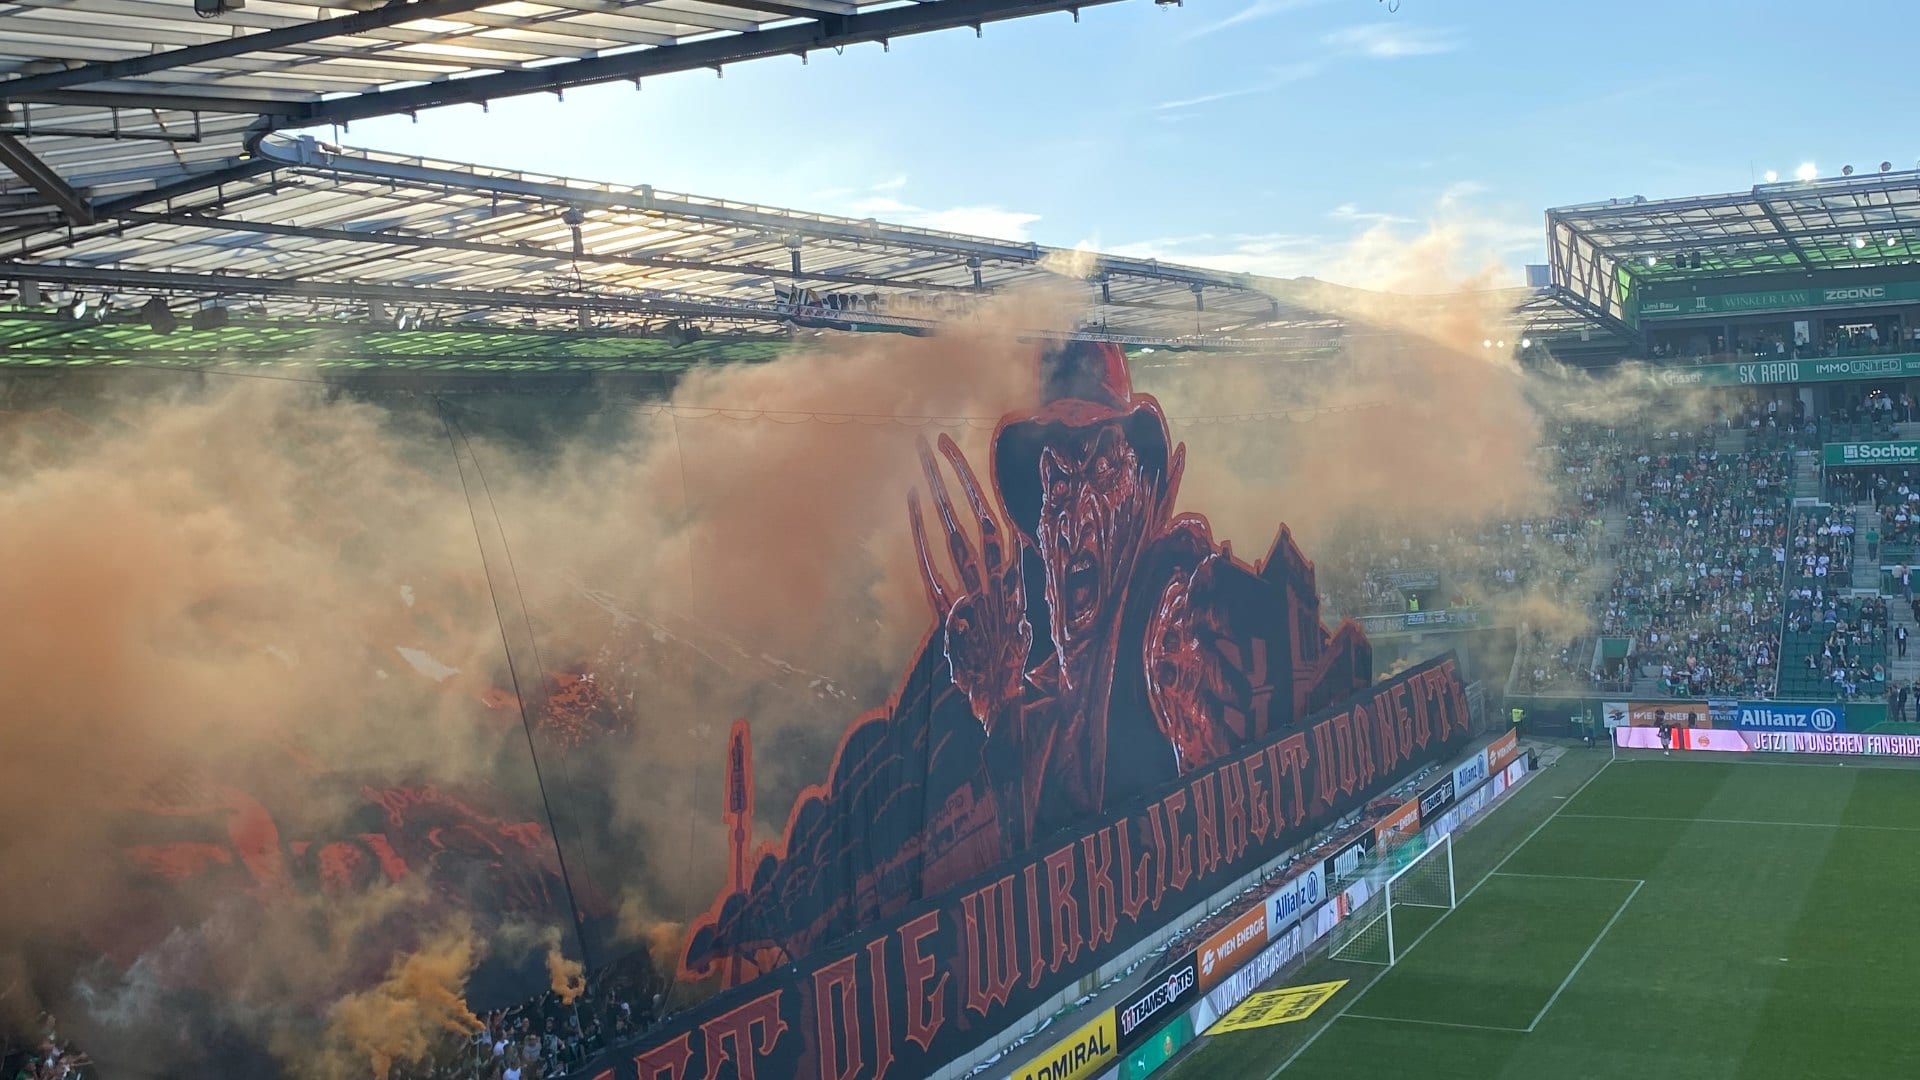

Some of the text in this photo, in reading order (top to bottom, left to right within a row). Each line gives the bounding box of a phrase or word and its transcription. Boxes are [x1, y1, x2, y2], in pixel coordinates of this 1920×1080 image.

[1826, 288, 1885, 300] ZGONC
[1740, 363, 1799, 383] SK RAPID
[1816, 363, 1850, 374] IMMO
[1859, 444, 1918, 458] Sochor
[1633, 711, 1706, 720] WIE ENERIE
[1740, 709, 1807, 727] Allianz
[1754, 733, 1787, 750] JETZT
[1793, 734, 1805, 751] IN
[1809, 735, 1863, 753] UNSEREN
[812, 909, 950, 1080] DIE
[960, 732, 1310, 1017] WIRKLICHKEIT
[1275, 887, 1306, 924] Allianz
[1216, 916, 1265, 961] WIEN ENERGIE
[1024, 1025, 1110, 1080] DMIRAL
